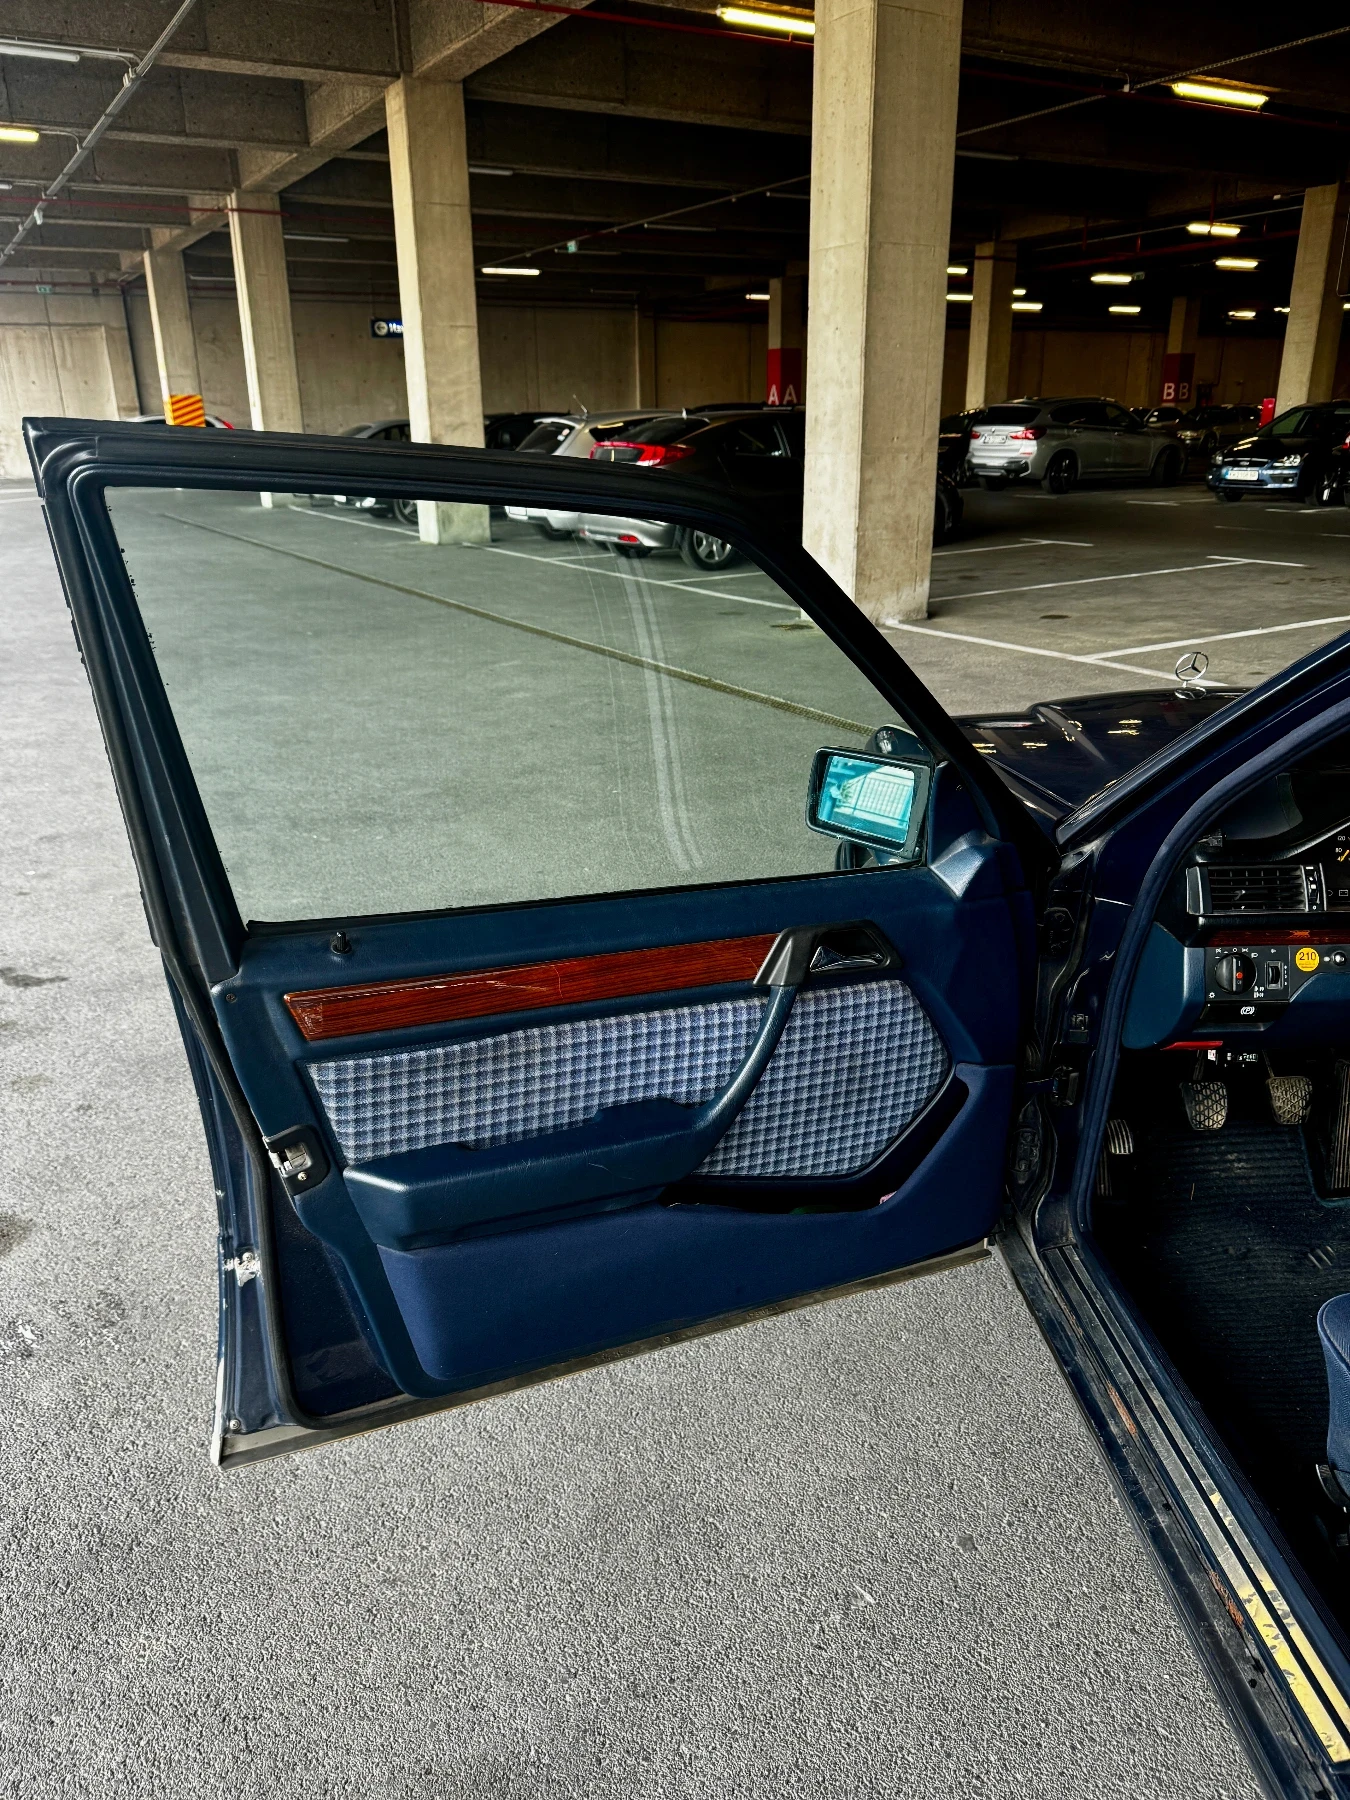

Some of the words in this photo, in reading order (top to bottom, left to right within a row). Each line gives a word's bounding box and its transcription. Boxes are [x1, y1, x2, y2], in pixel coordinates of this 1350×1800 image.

[768, 384, 779, 405] A
[783, 384, 797, 405] A
[1163, 383, 1175, 400] B
[1179, 383, 1189, 399] B
[1298, 951, 1317, 961] 210
